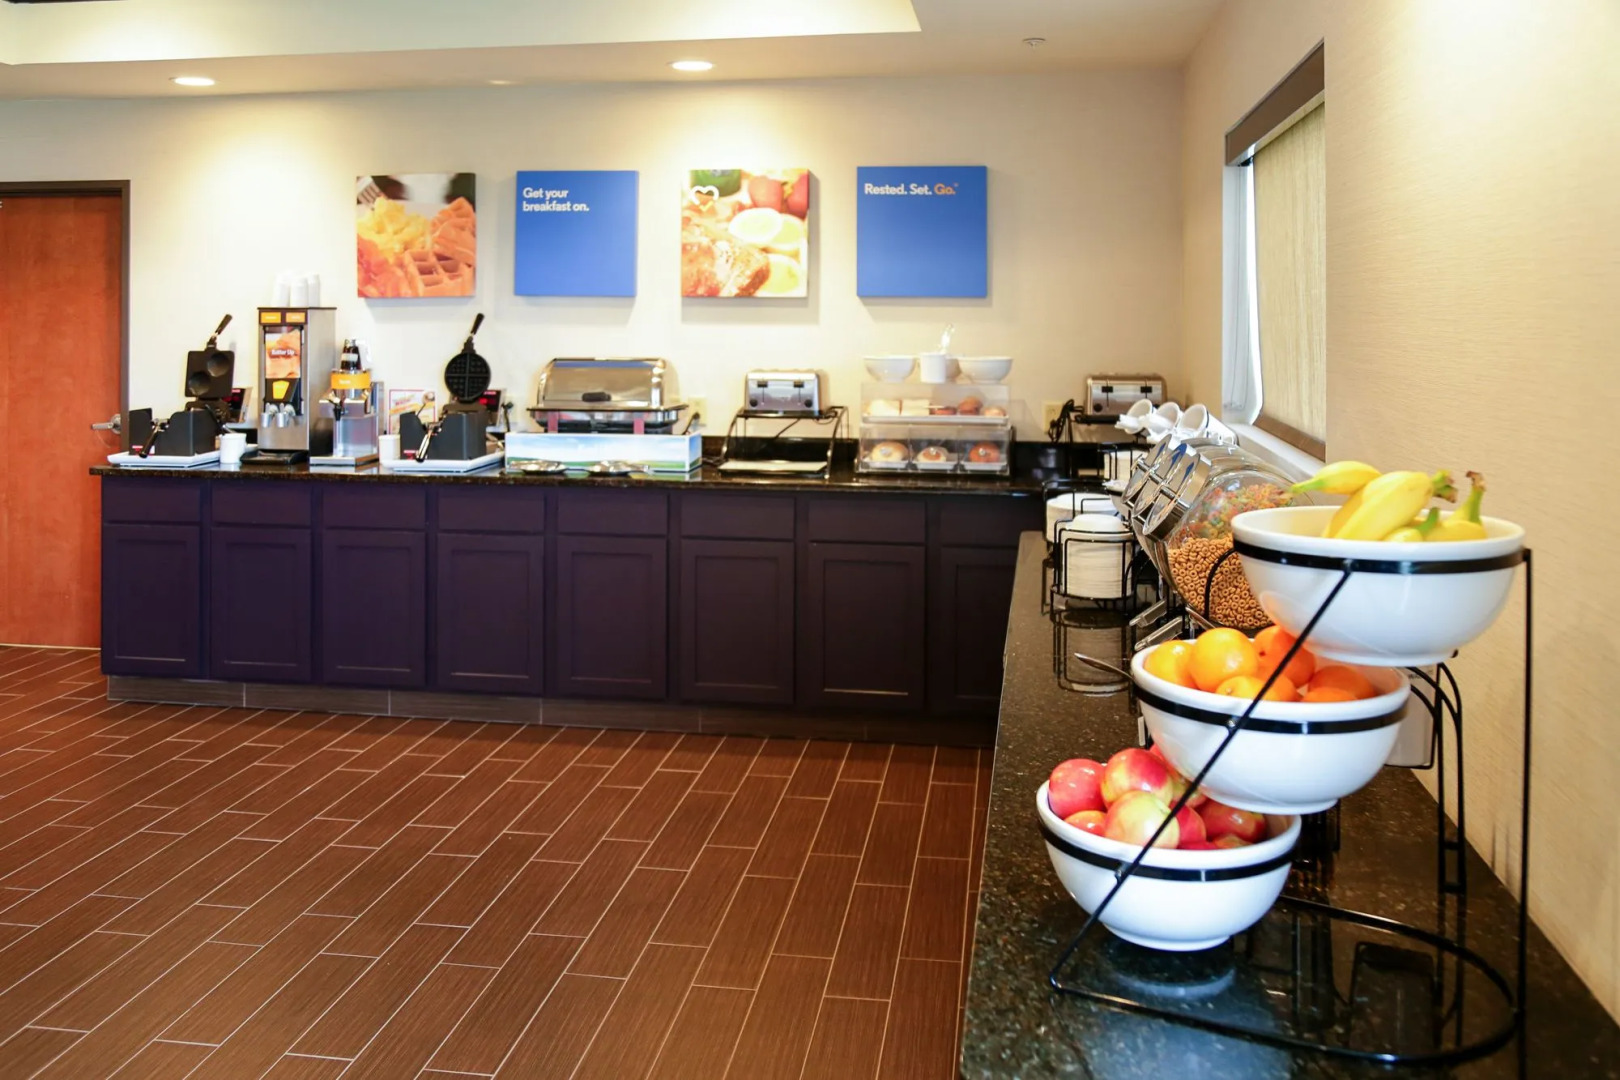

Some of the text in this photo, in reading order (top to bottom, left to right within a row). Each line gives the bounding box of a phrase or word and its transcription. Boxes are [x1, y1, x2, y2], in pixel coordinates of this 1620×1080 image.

[522, 187, 569, 200] Get your
[864, 183, 907, 195] Rested.
[909, 183, 932, 195] Set.
[522, 201, 590, 211] breakfast on.
